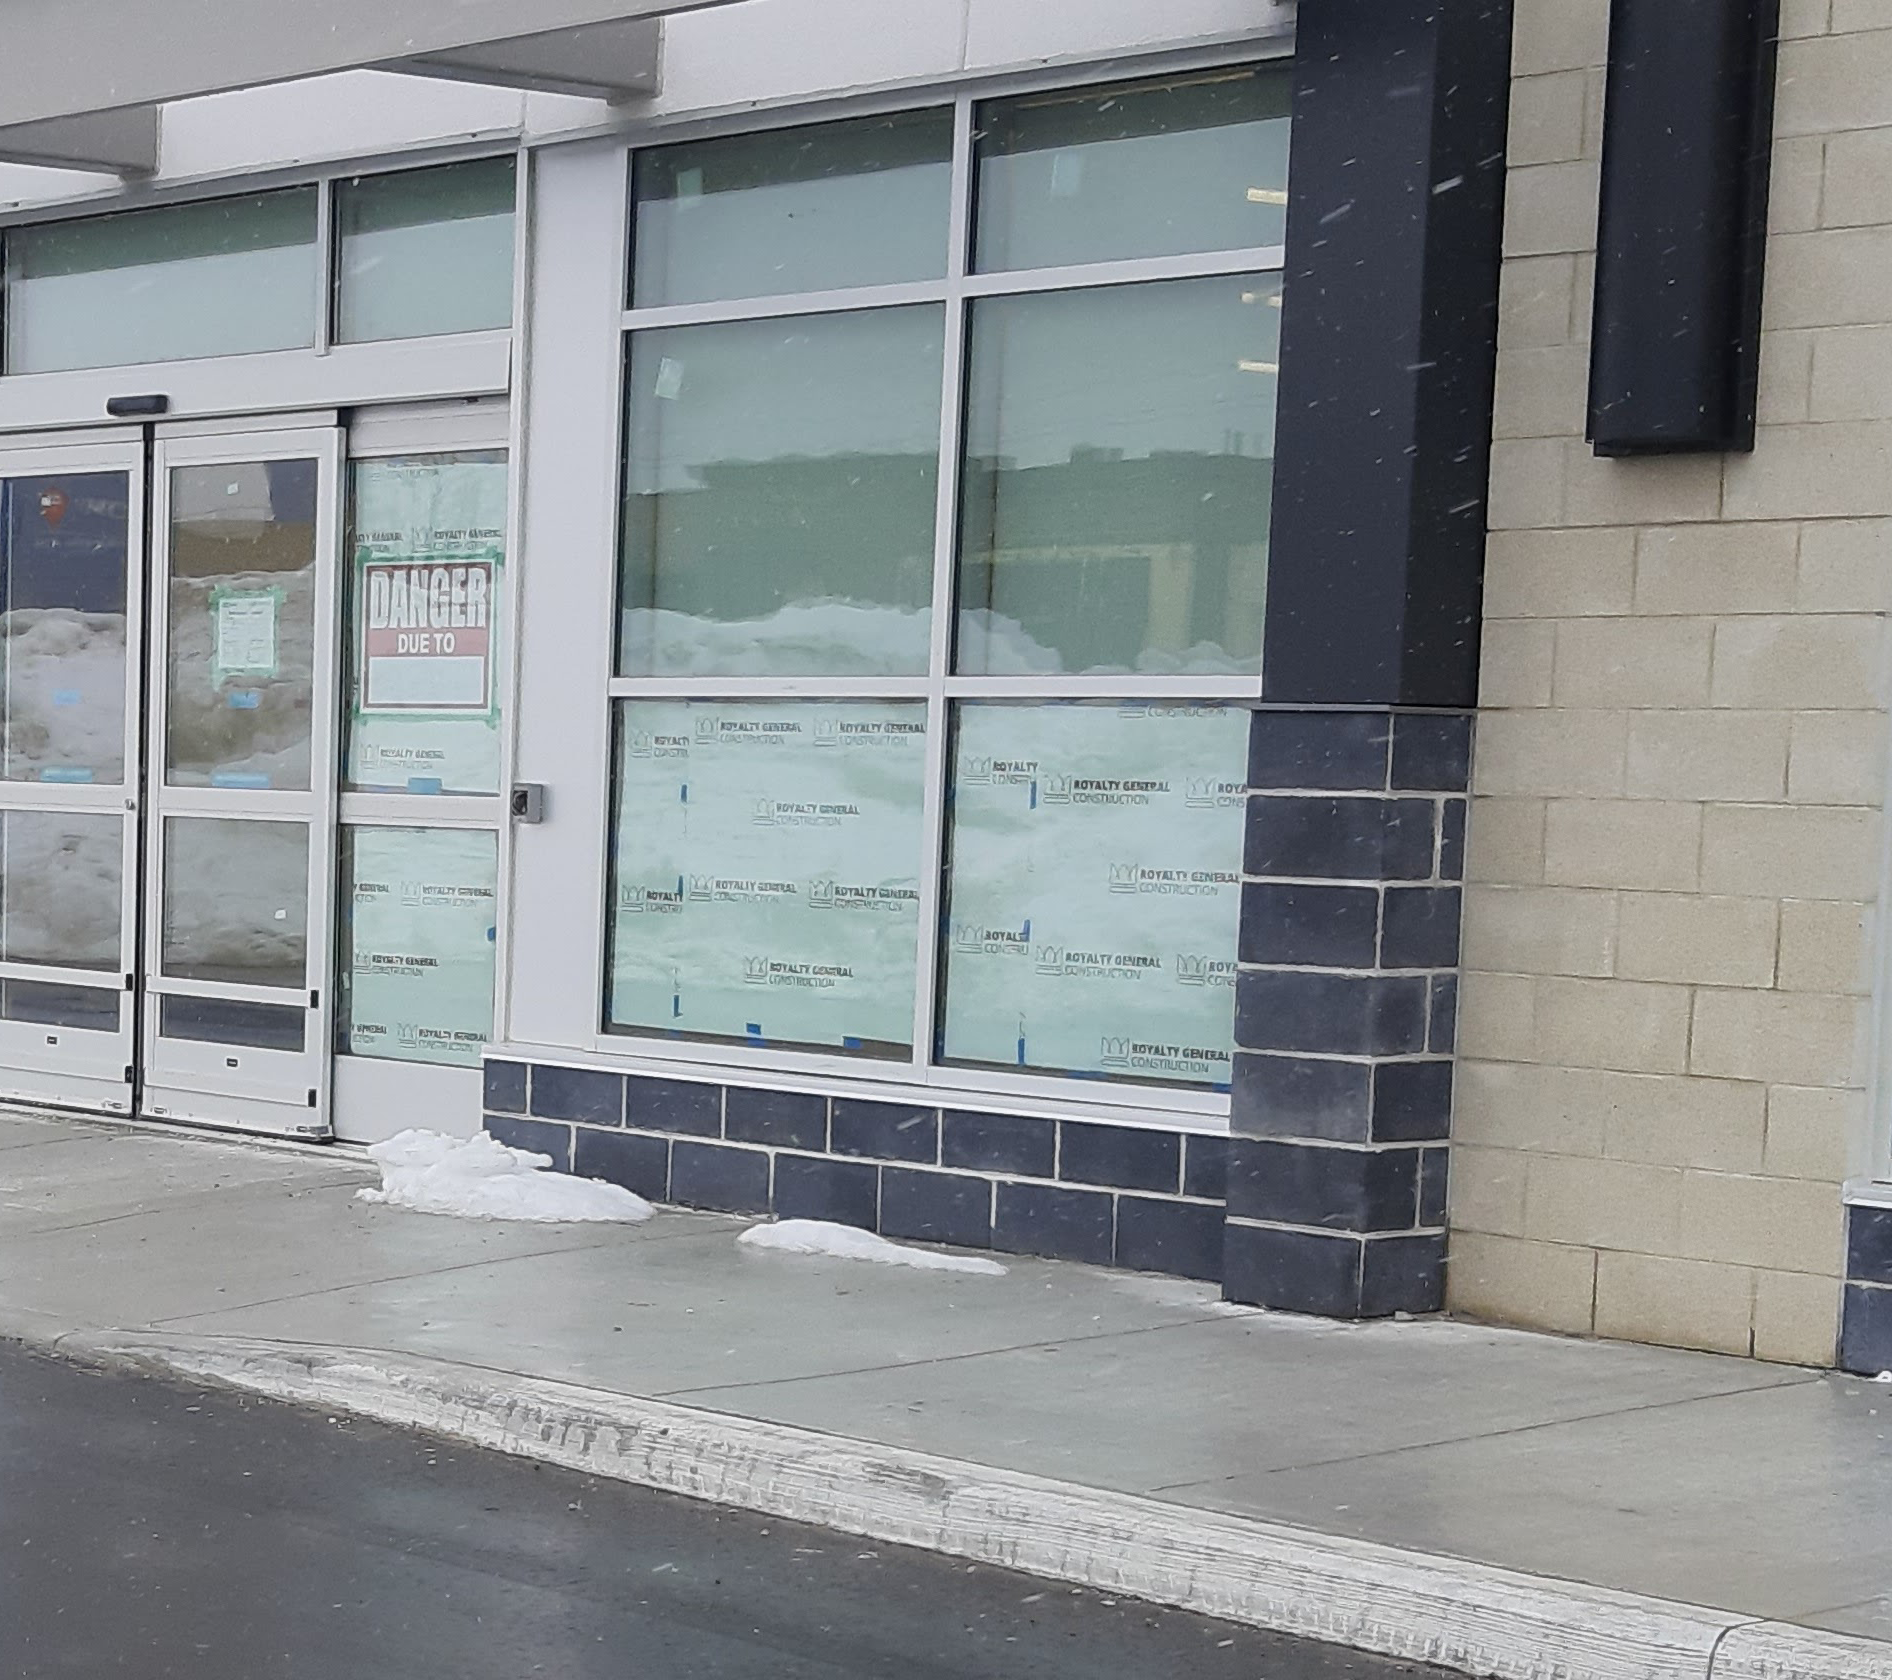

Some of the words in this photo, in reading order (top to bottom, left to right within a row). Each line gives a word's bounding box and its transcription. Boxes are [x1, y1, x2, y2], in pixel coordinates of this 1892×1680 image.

[369, 568, 487, 629] DANGER
[398, 634, 430, 654] DUE
[433, 633, 455, 654] TO
[720, 722, 760, 732] ROYALTY
[839, 722, 882, 733] ROYALTY
[992, 761, 1038, 773] ROYALTY
[1073, 779, 1120, 791] ROYALTY
[1122, 781, 1171, 793] GENERAL
[1072, 792, 1149, 805] CONSTRUCTION
[776, 803, 817, 814] ROYALTY
[1140, 868, 1188, 881] ROYALTY
[1191, 871, 1240, 884] GENERAL
[715, 879, 756, 891] ROYALTY
[1139, 882, 1219, 896] CONSTRUCTION
[835, 886, 877, 899] ROYALTY
[879, 888, 920, 901] GENERAL
[1065, 951, 1113, 965] ROYALTY
[1114, 955, 1162, 969] GENERAL
[769, 962, 810, 974] ROYALTY
[812, 965, 854, 978] GENERAL
[1132, 1043, 1181, 1057] ROYALTY
[1182, 1047, 1231, 1063] GENERAL
[1131, 1055, 1211, 1073] CONSTRUCTION
